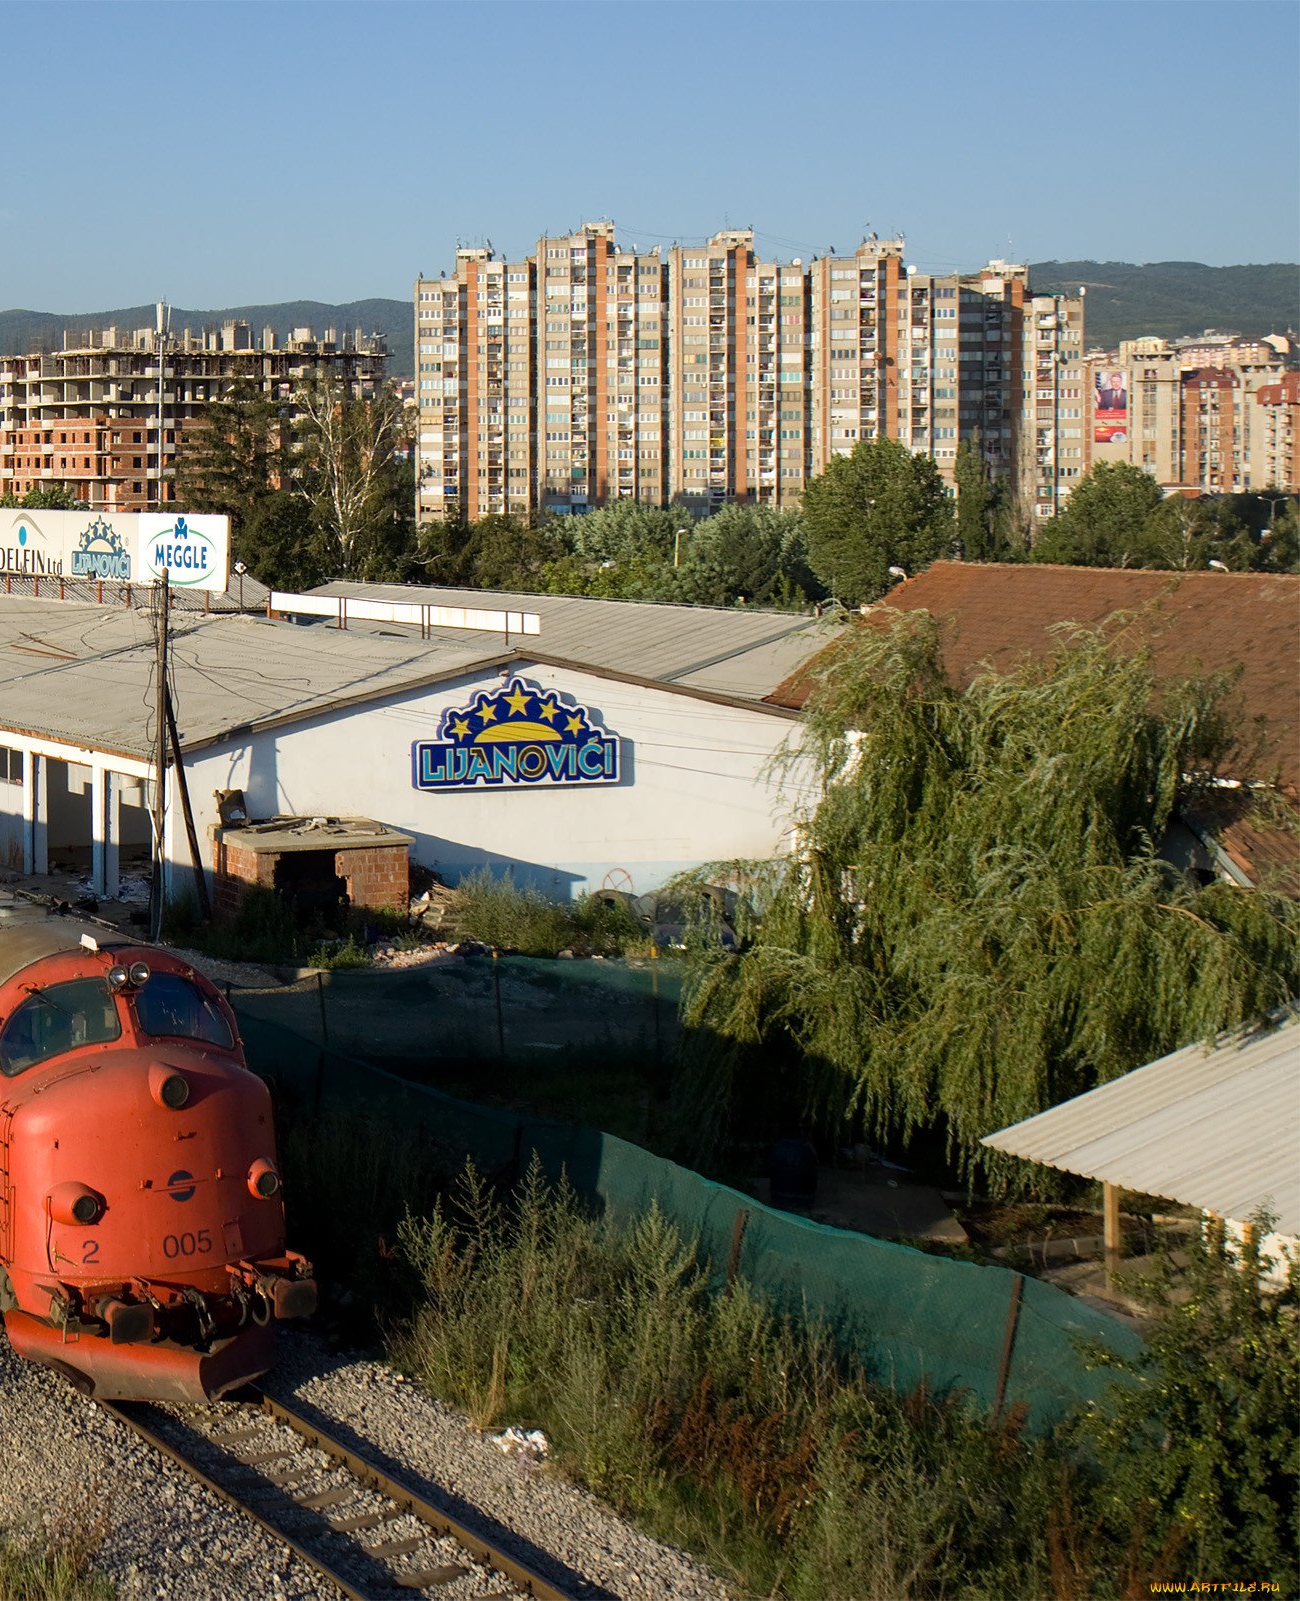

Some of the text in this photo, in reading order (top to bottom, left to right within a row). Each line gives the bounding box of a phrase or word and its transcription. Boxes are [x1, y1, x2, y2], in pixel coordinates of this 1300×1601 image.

[47, 557, 63, 575] Ltd
[155, 544, 207, 569] MEGGLE
[422, 736, 613, 782] LIJANOVIĆI
[81, 1239, 100, 1265] 2
[162, 1229, 213, 1259] 005
